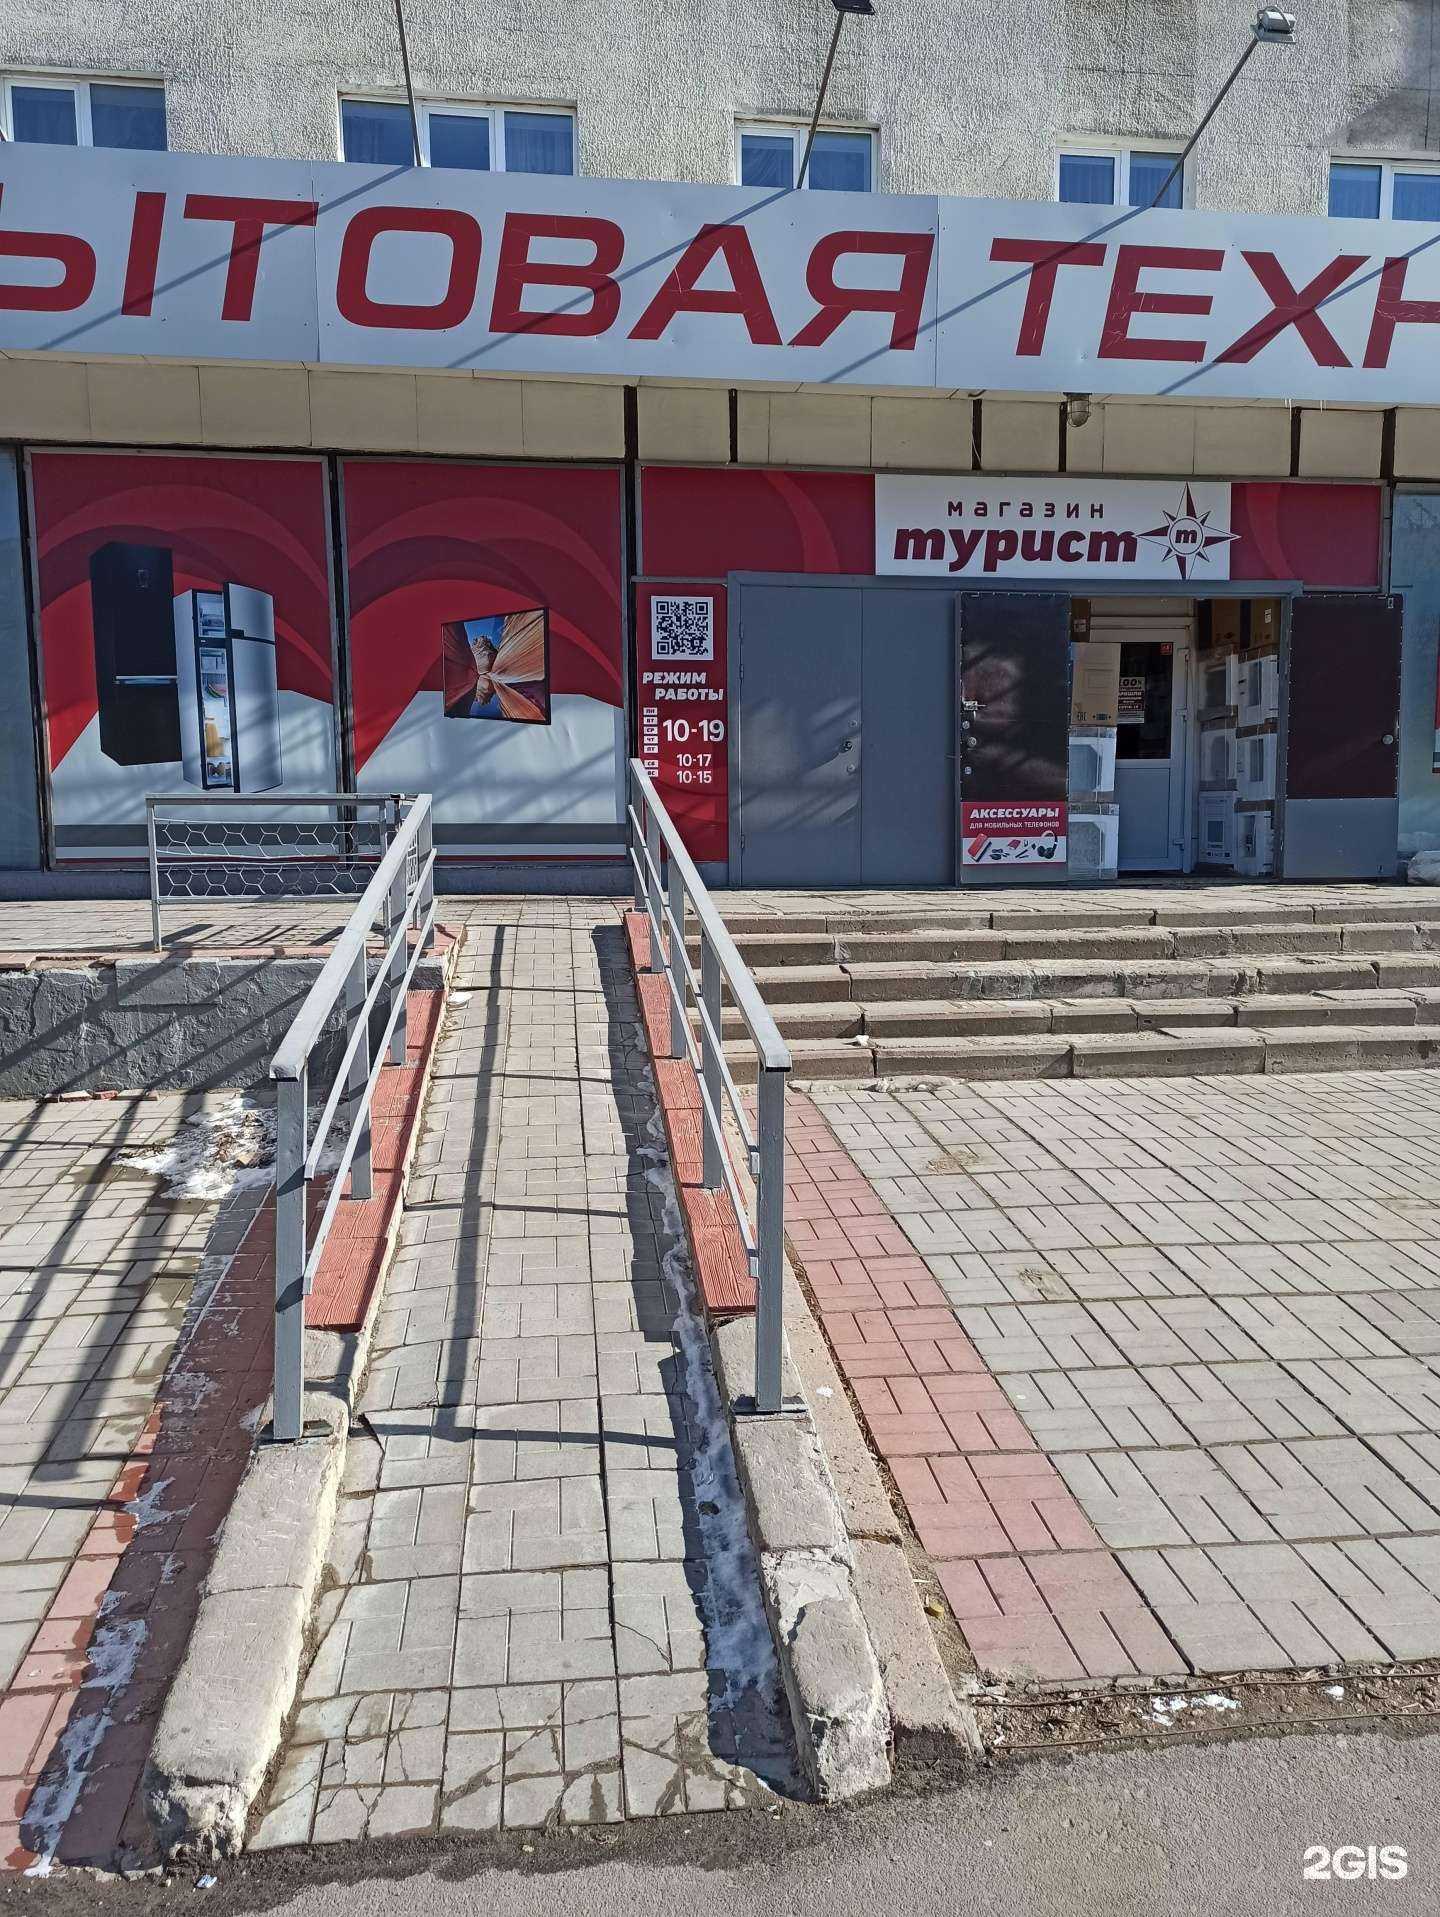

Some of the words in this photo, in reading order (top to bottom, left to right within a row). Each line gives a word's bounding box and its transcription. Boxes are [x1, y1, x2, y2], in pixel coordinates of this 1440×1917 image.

[947, 500, 1105, 519] магазин
[893, 527, 1139, 574] турист
[642, 671, 707, 685] РЕЖИМ
[654, 687, 725, 702] РАБОТЫ
[662, 718, 725, 742] 10-19
[676, 753, 712, 767] 10-17
[676, 770, 713, 784] 10-15
[969, 807, 1060, 819] АКСЕССУАРЫ
[969, 822, 983, 830] ДЛЯ
[984, 821, 1023, 829] МОБИЛЬНЫХ
[1024, 821, 1060, 829] ТЕЛЕФОНОВ
